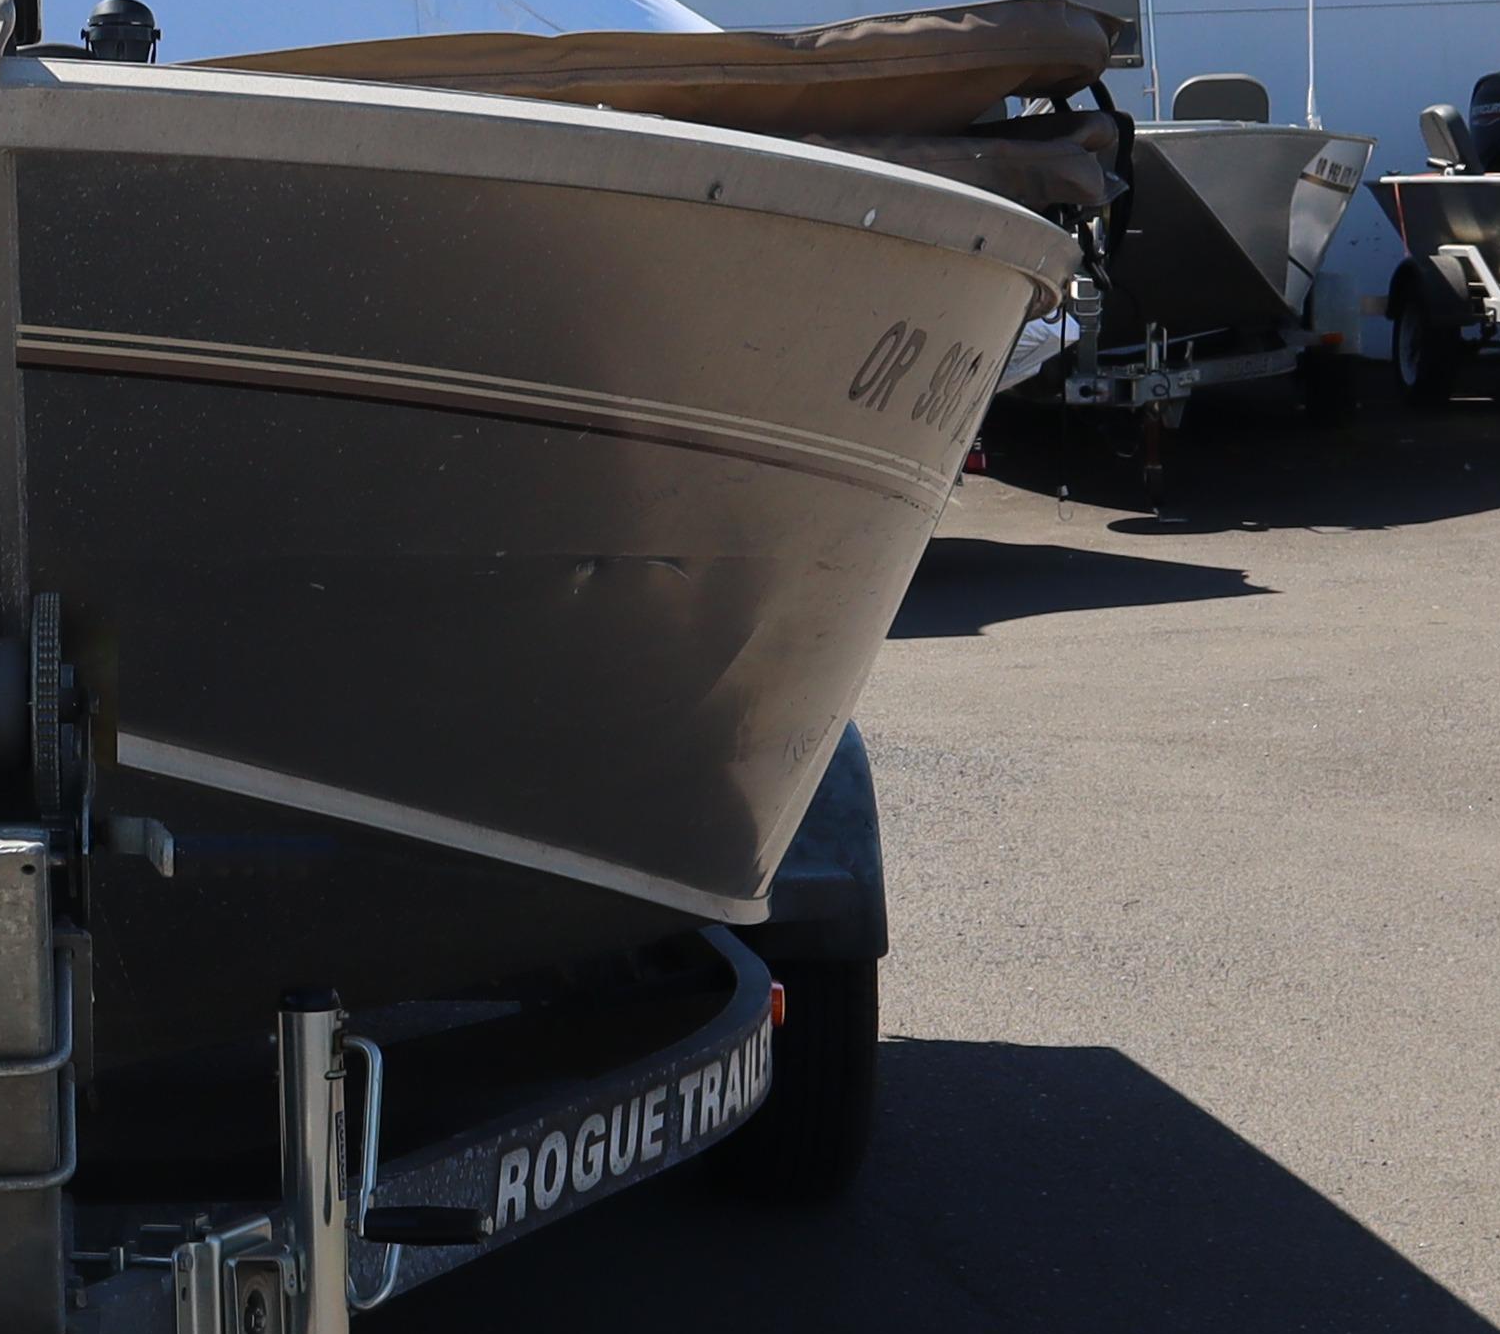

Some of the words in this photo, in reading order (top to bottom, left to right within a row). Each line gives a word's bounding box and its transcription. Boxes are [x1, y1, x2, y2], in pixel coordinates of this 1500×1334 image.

[848, 320, 928, 412] OR
[495, 1084, 668, 1232] ROGUE
[678, 1012, 771, 1146] TRAILE
